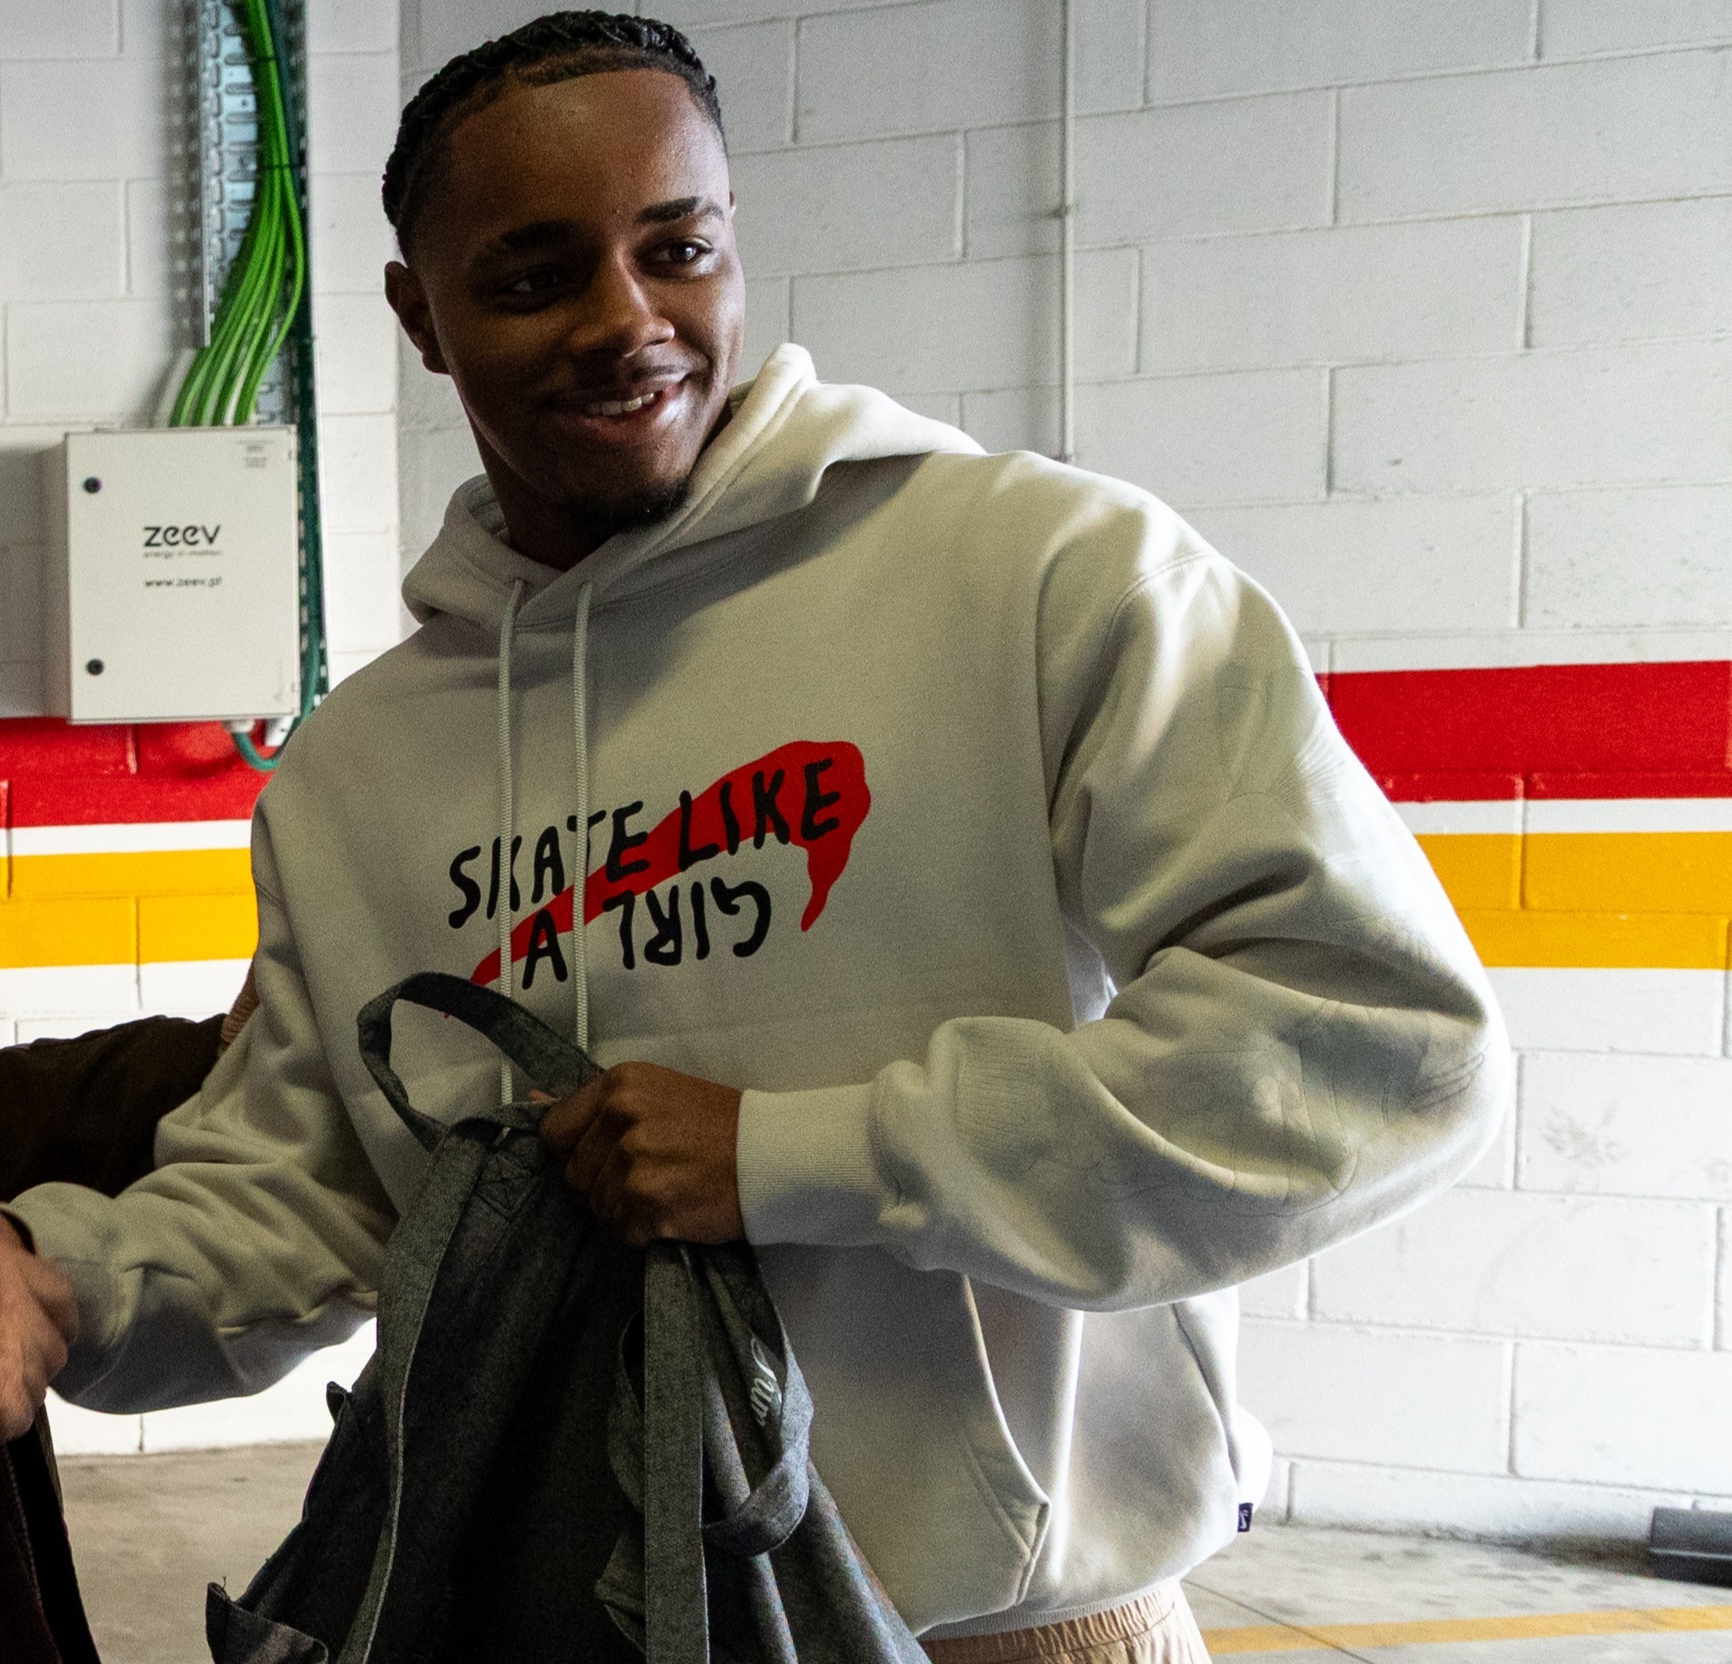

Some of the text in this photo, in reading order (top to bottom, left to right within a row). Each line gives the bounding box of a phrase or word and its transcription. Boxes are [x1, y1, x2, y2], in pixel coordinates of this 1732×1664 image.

[143, 524, 222, 547] zeev
[448, 758, 841, 929] SKATE LIKE
[522, 876, 772, 990] A GIRL
